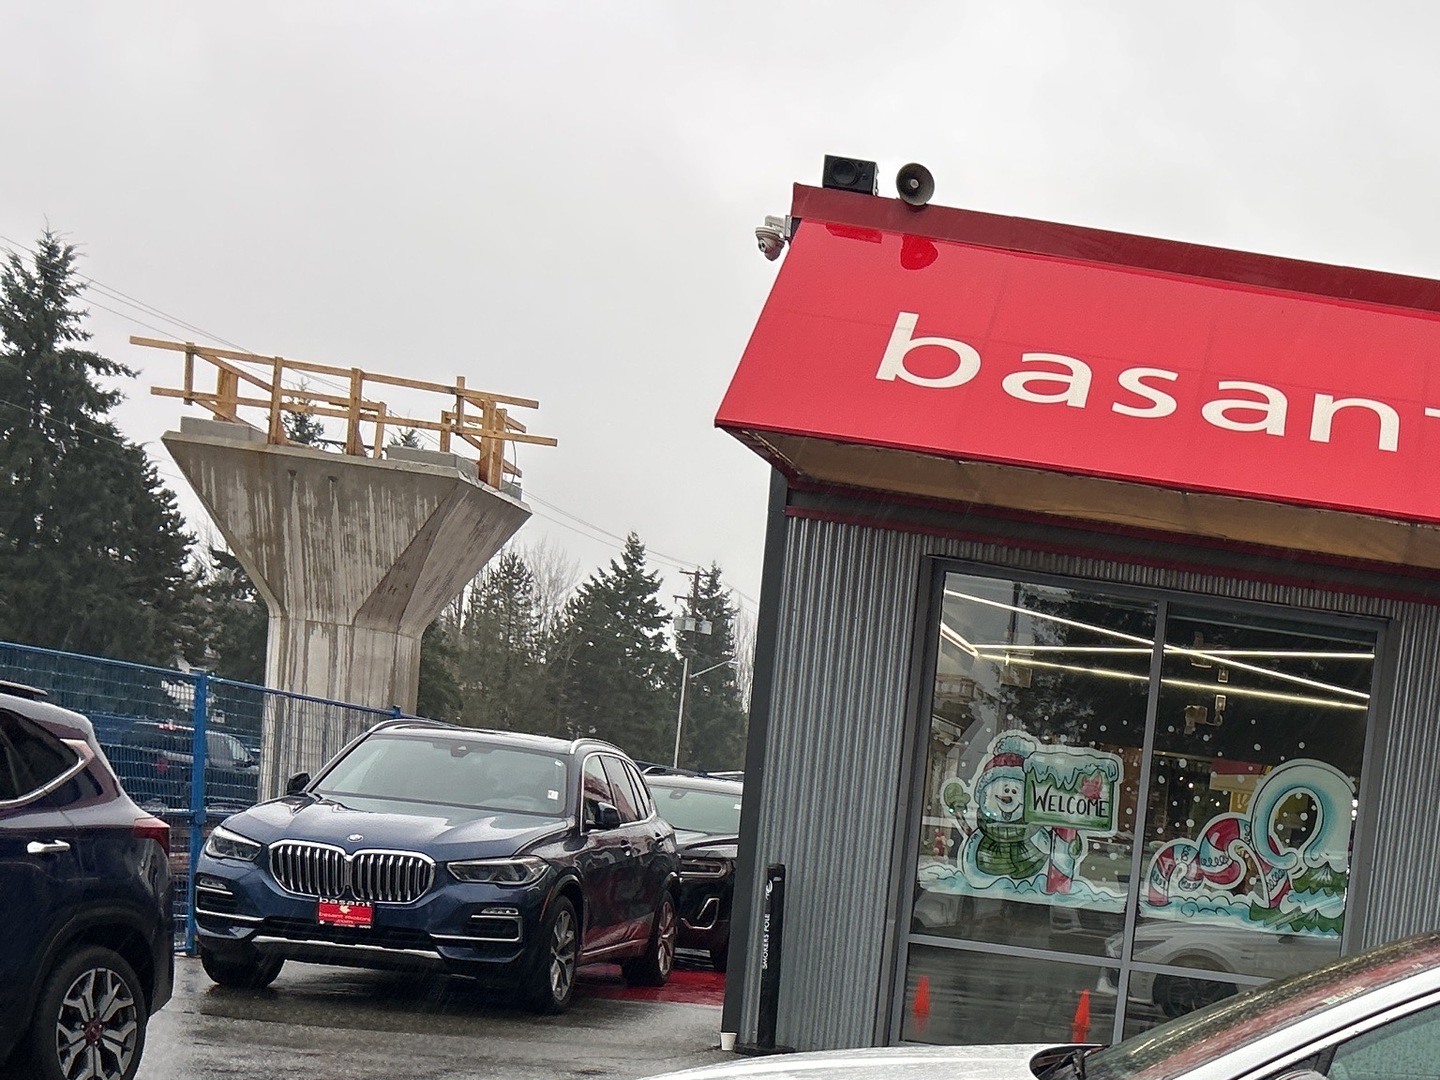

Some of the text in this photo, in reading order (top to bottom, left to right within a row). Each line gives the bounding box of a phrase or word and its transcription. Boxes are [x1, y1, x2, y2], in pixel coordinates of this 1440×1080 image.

[1031, 780, 1110, 818] WELCOME
[319, 897, 372, 908] basant
[762, 913, 771, 969] SMOKERS POLE
